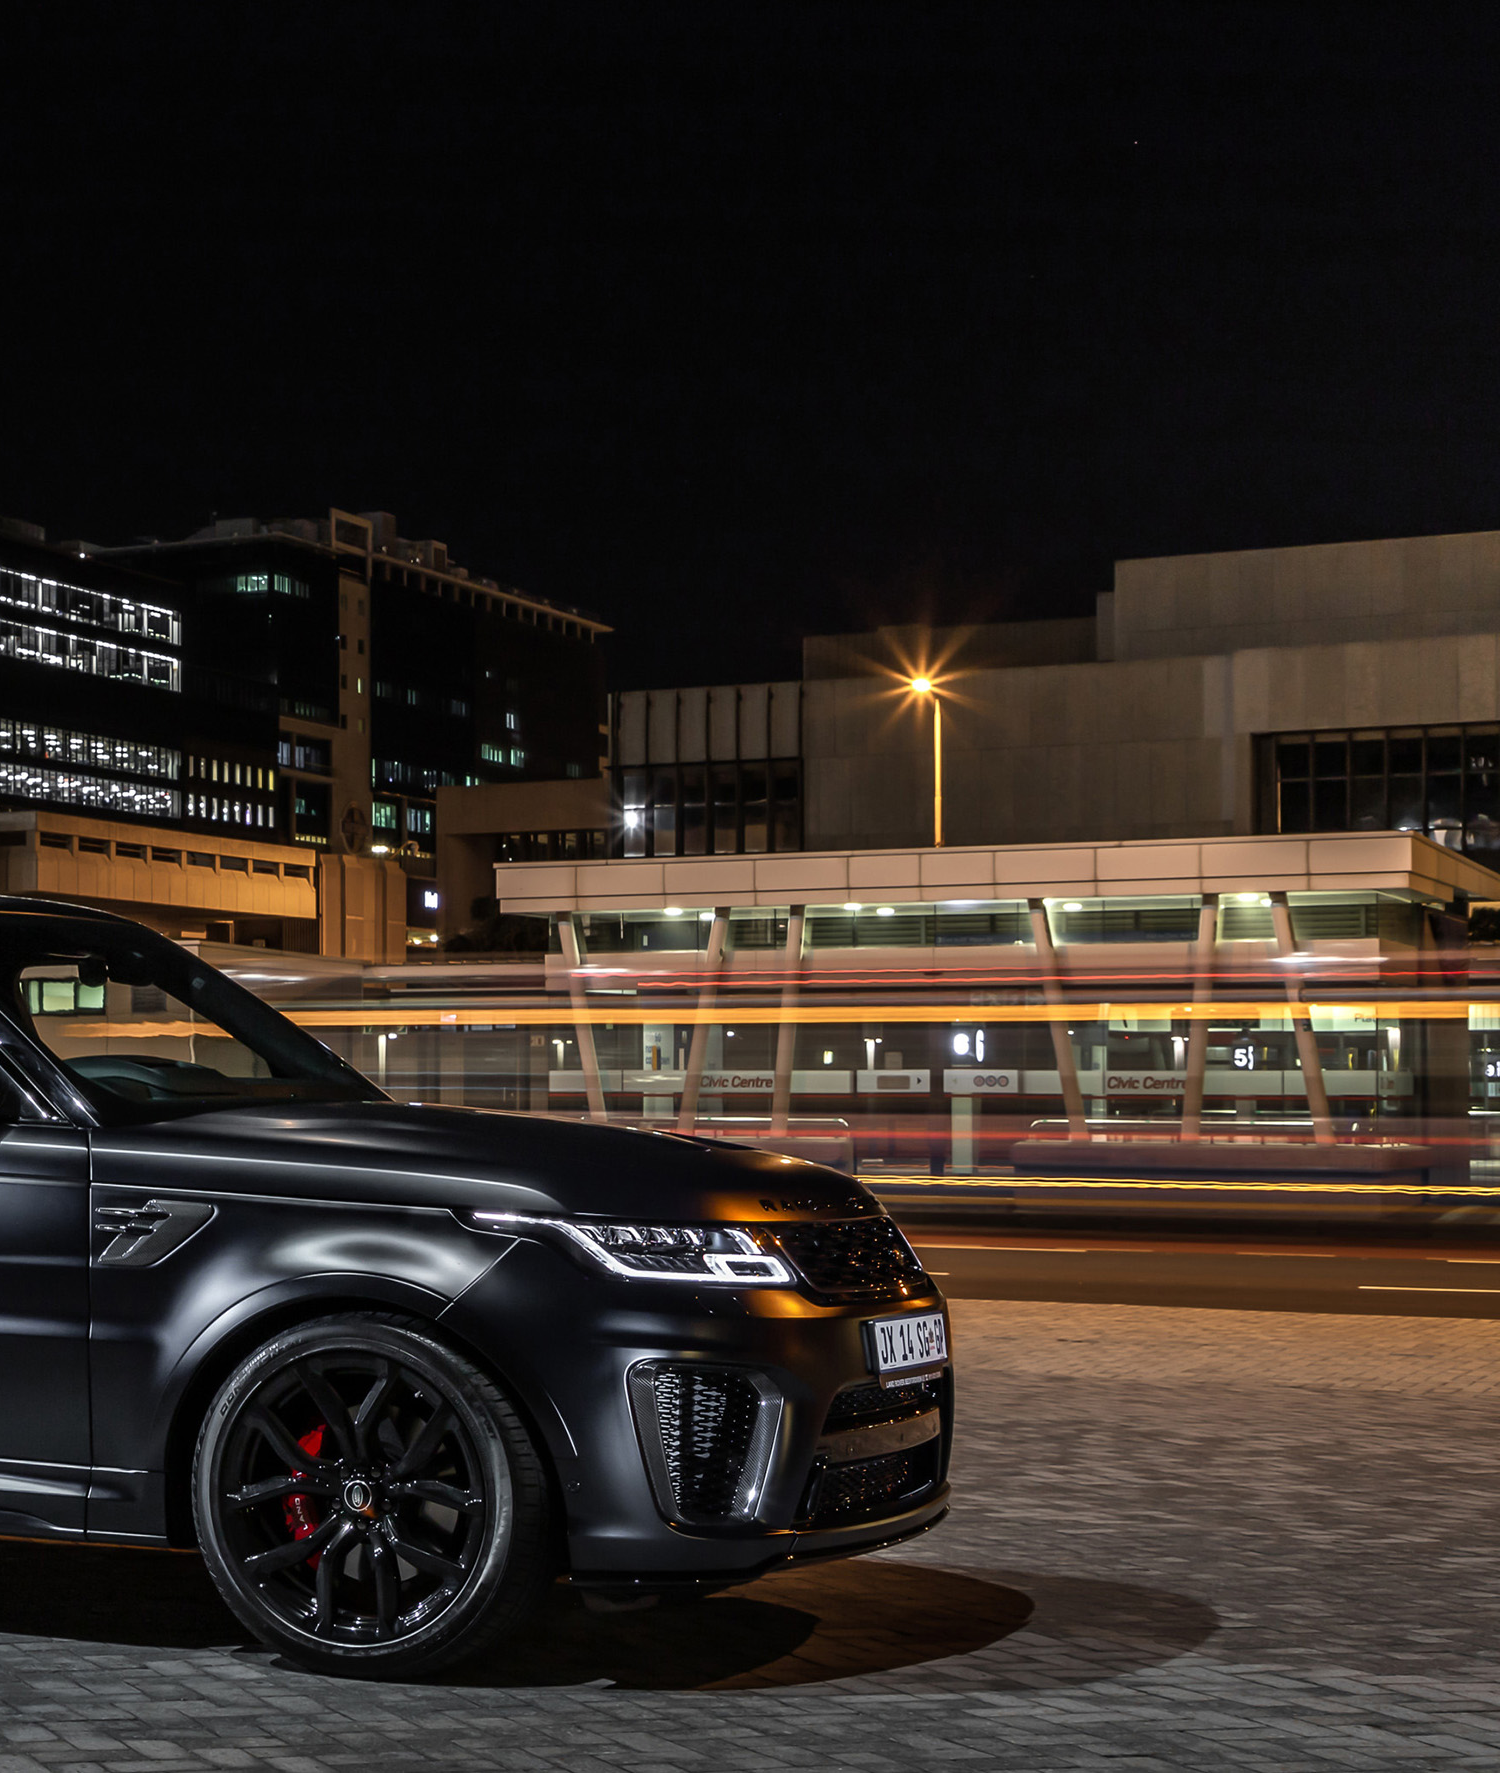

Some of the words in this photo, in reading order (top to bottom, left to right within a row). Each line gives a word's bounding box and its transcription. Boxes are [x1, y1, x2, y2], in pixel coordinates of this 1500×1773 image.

[1234, 1048, 1248, 1067] 5
[700, 1075, 729, 1088] Civic
[731, 1075, 773, 1088] Centre
[1107, 1076, 1140, 1089] Civic
[880, 1325, 897, 1365] JX
[899, 1323, 915, 1362] 14
[916, 1320, 931, 1359] SG
